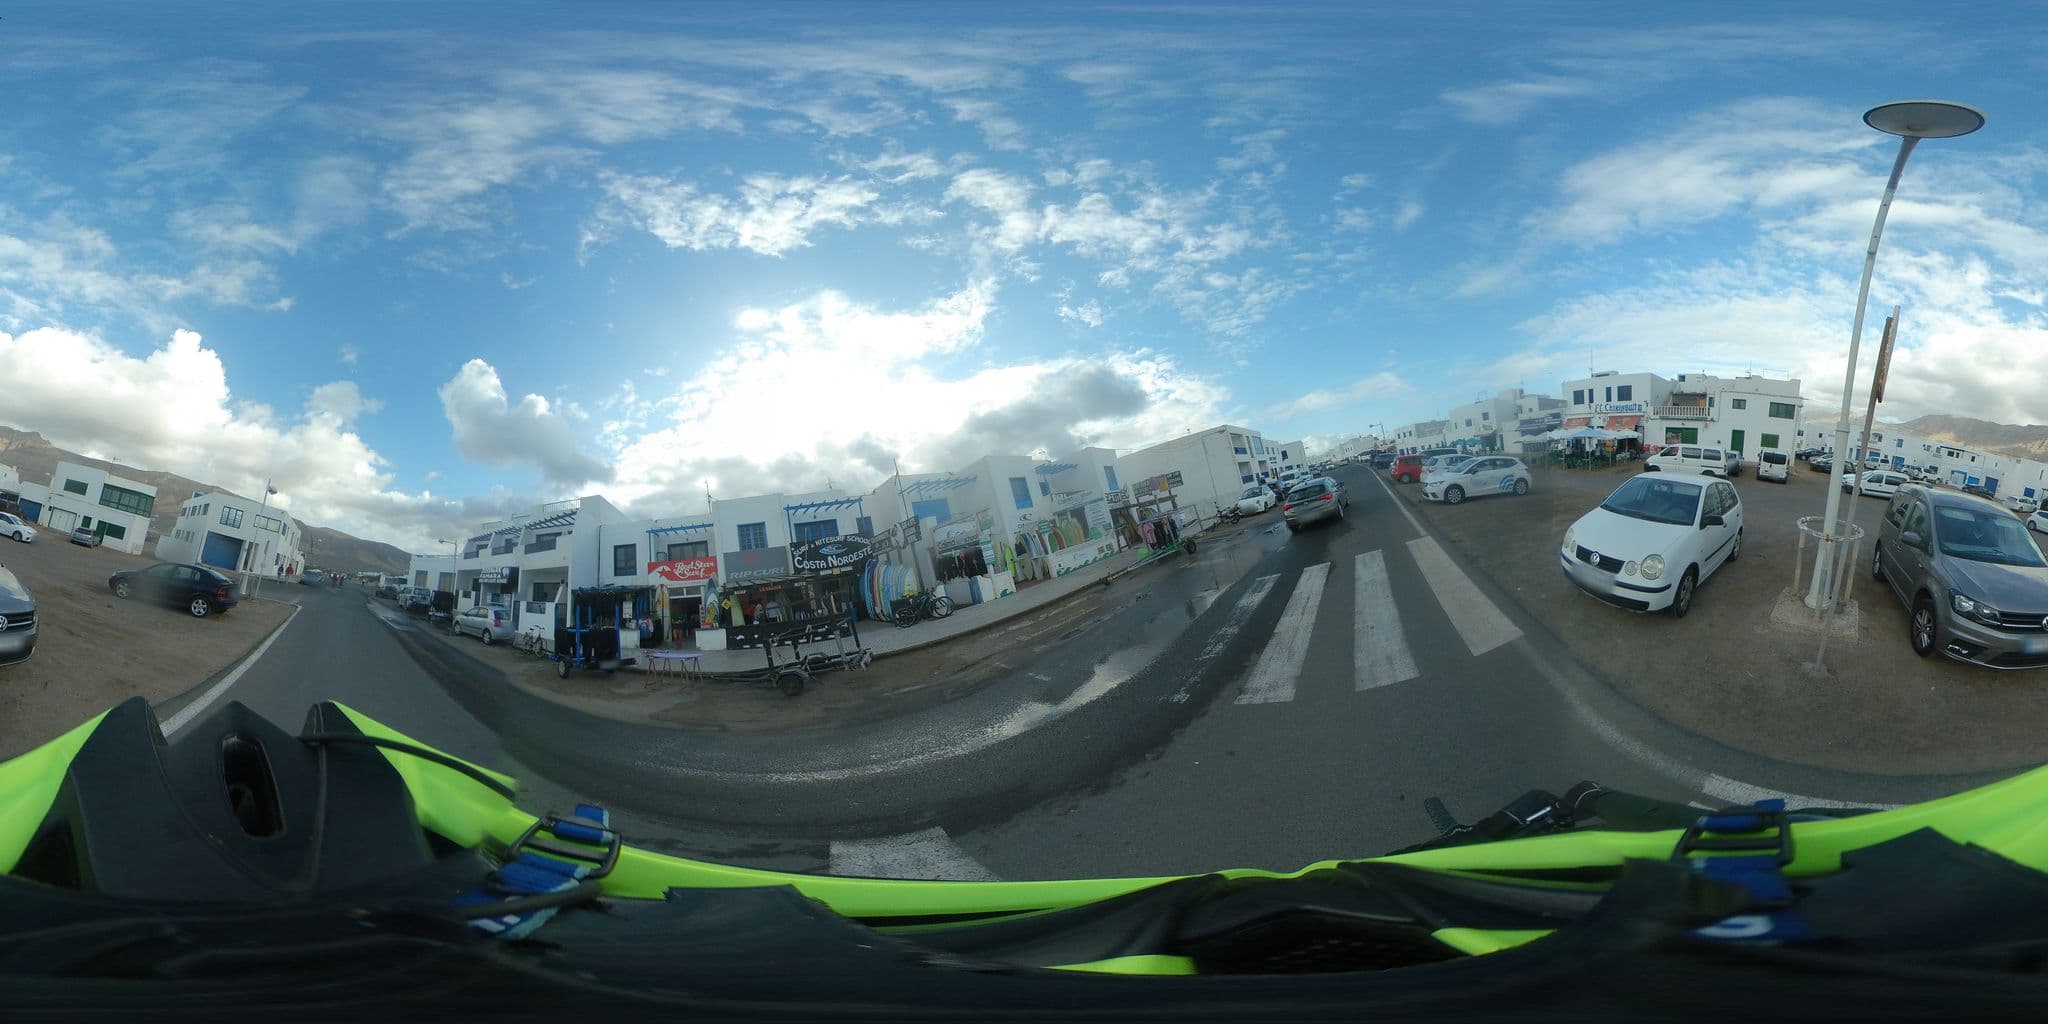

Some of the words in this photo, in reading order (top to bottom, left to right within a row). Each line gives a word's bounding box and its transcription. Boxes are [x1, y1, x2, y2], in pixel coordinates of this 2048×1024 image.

[793, 543, 809, 556] SURF
[815, 535, 845, 547] KITESURF
[846, 535, 872, 546] SCHOOL
[794, 556, 827, 569] COSTA
[828, 545, 873, 567] NOROESTE
